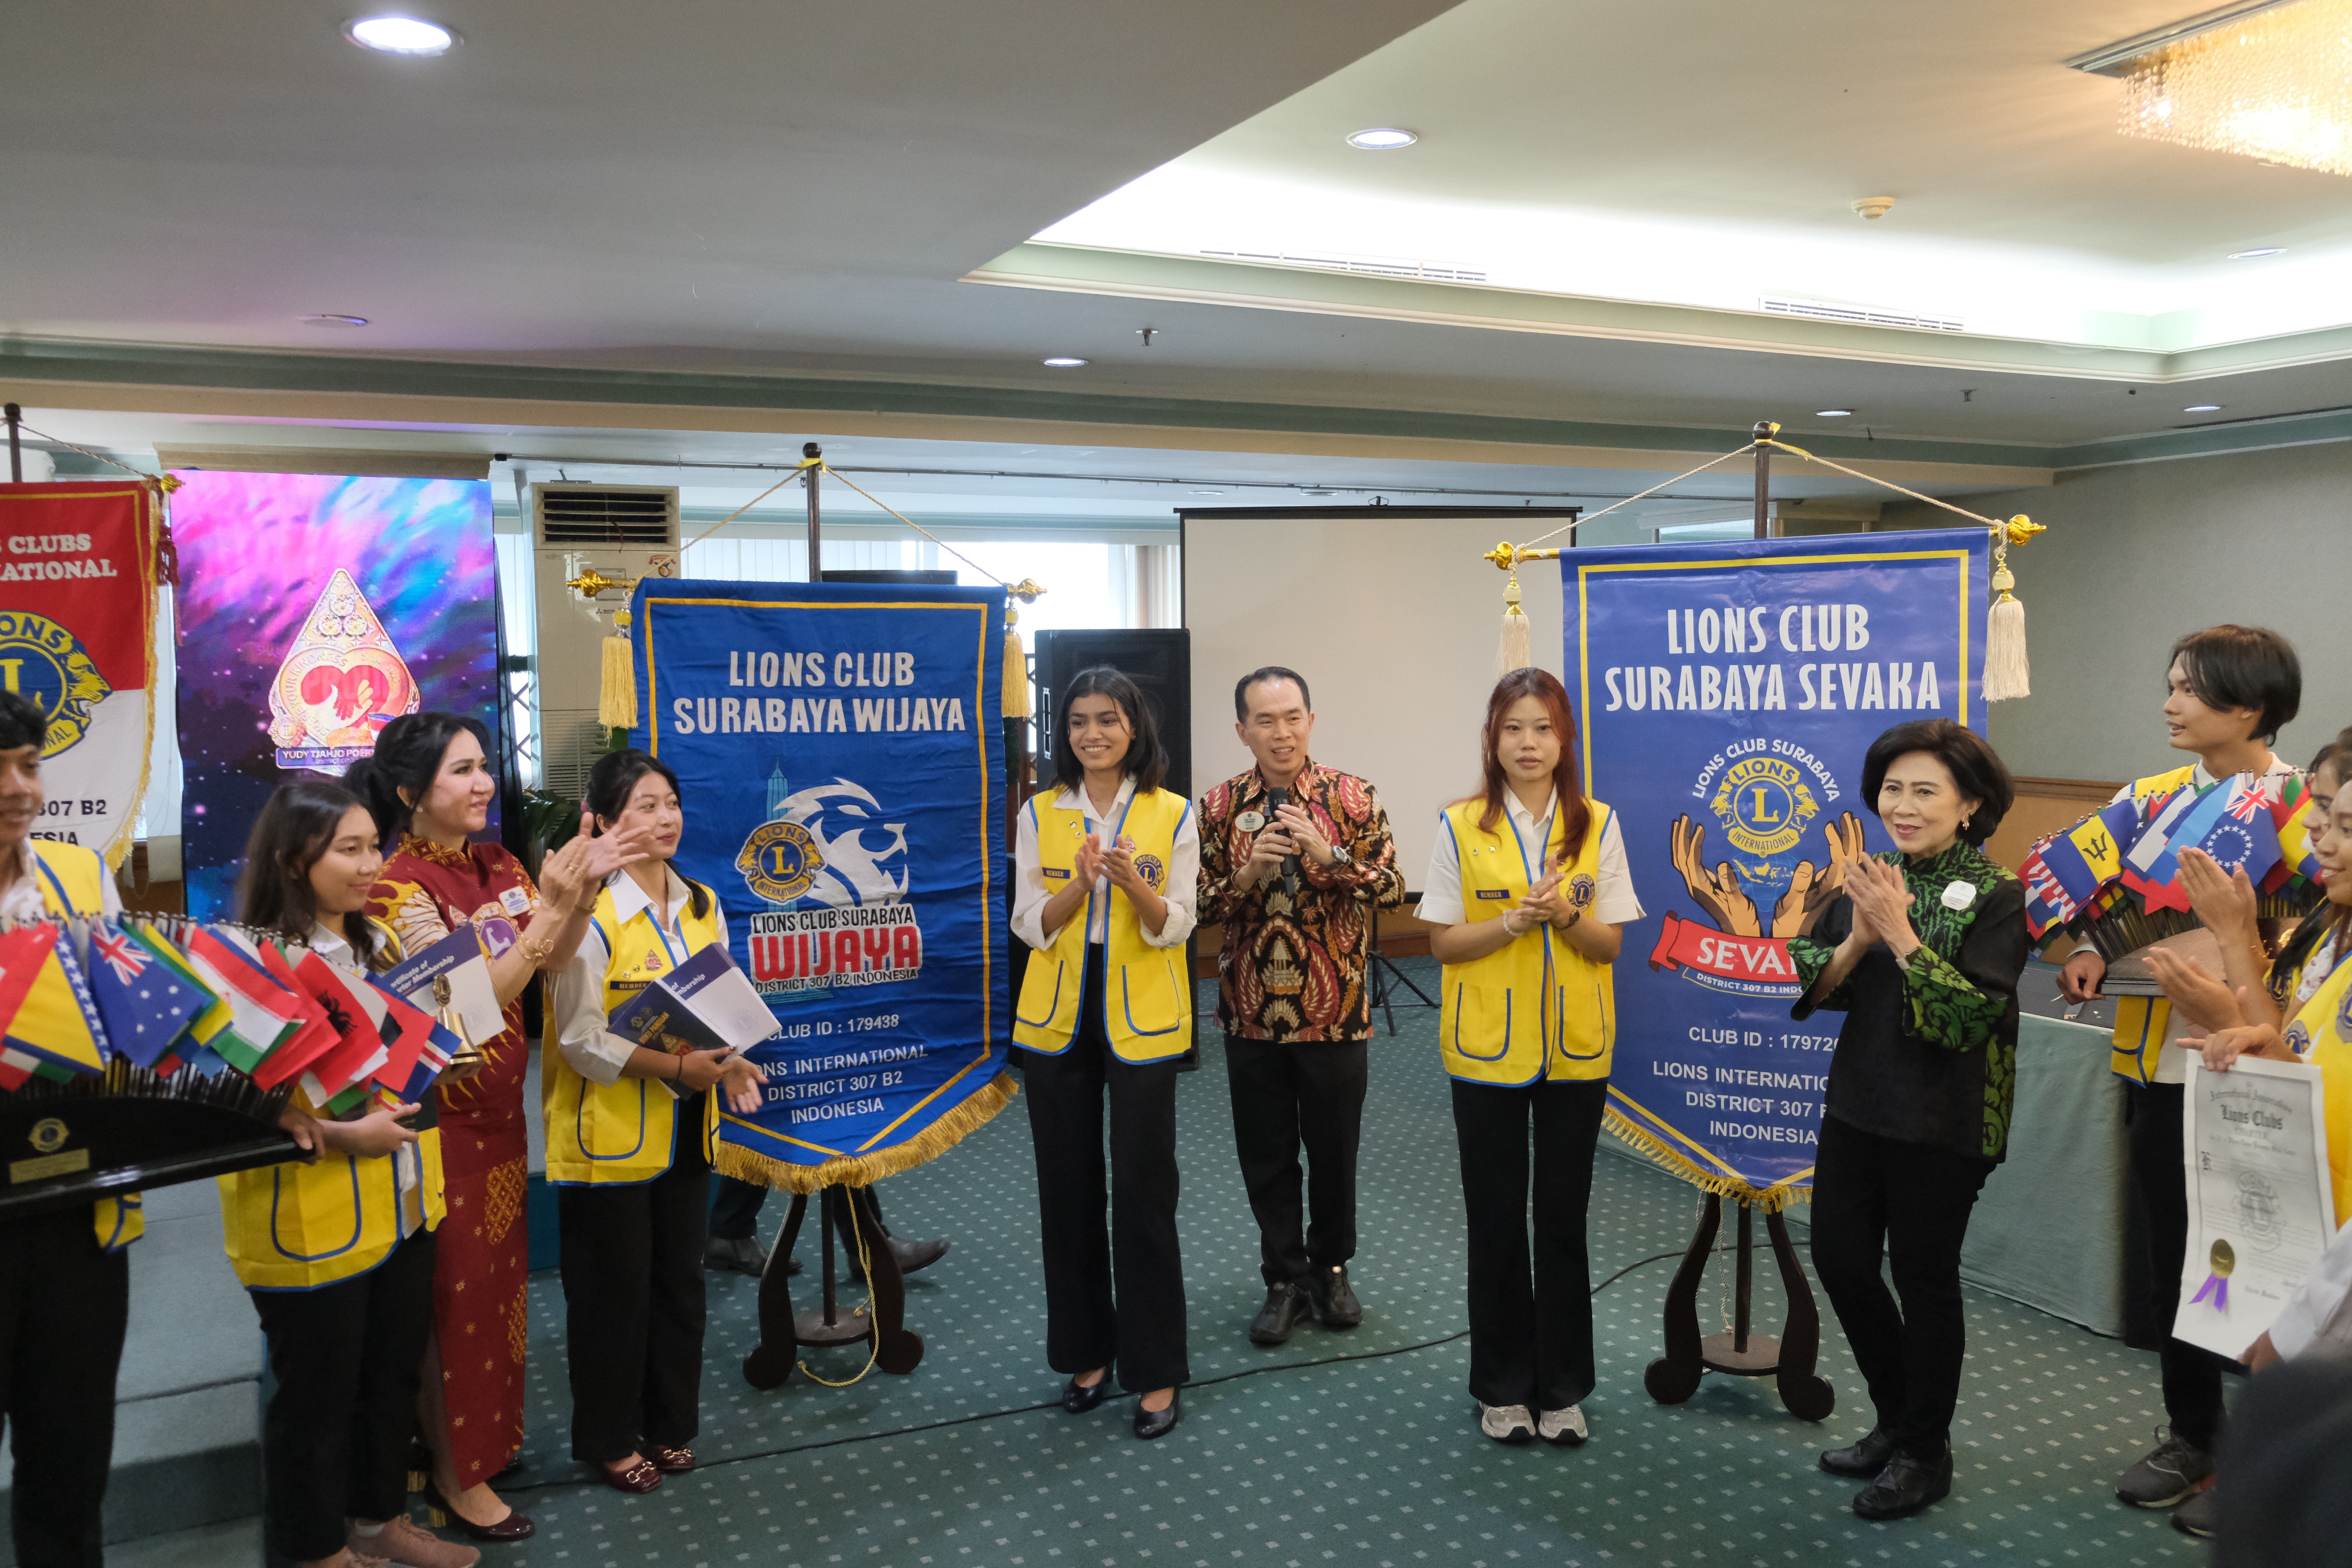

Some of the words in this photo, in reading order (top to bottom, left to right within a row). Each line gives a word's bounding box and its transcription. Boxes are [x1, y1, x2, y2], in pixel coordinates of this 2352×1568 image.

[8, 533, 92, 554] CLUBS
[0, 559, 118, 581] ATIONAL
[0, 615, 66, 649] ONS
[1667, 606, 1766, 654] LIONS
[1779, 604, 1870, 652] CLUB
[729, 651, 826, 688] LIONS
[834, 652, 915, 688] CLUB
[1604, 664, 1786, 712] SURABAYA
[1798, 661, 1941, 710] SEVAKA
[674, 698, 847, 734] SURABAYA
[853, 697, 965, 732] WIJAYA
[1692, 754, 1725, 799] LIONS
[1726, 738, 1766, 758] CLUB
[1771, 739, 1840, 802] SURABAYA
[1732, 760, 1796, 782] LIONS
[80, 799, 106, 815] B2
[1751, 788, 1779, 822] L
[757, 825, 806, 842] LIONS
[1732, 831, 1795, 850] INTERNATIONAL
[772, 846, 795, 874] L
[1137, 855, 1159, 866] LIONS
[758, 881, 806, 896] INTERNATIONAL
[753, 914, 796, 934] LIONS
[800, 910, 837, 930] CLUB
[841, 906, 914, 926] SURABAYA
[751, 926, 919, 982] WIJAYA
[390, 967, 420, 988] ertificate
[671, 982, 679, 990] of
[678, 973, 706, 995] mbership
[756, 978, 805, 993] DISTRICT
[810, 975, 830, 988] 307
[835, 974, 850, 985] B2
[853, 969, 917, 985] INDONESIA
[1697, 972, 1741, 989] DISTRICT
[1742, 983, 1761, 992] 307
[816, 1021, 832, 1035] ID
[847, 1014, 899, 1032] 179438
[1689, 1026, 1738, 1044] CLUB
[1744, 1031, 1762, 1047] ID
[1780, 1034, 1839, 1052] 17972
[795, 1044, 928, 1074] INTERNATIONAL
[768, 1078, 845, 1101] DISTRICT
[850, 1074, 877, 1091] 307
[883, 1070, 902, 1086] B2
[1653, 1061, 1708, 1081] LIONS
[1715, 1067, 1829, 1092] INTERNATIO
[791, 1097, 884, 1124] INDONESIA
[1686, 1091, 1774, 1114] DISTRICT
[1780, 1100, 1813, 1117] 307
[1710, 1120, 1818, 1145] INDONESIA
